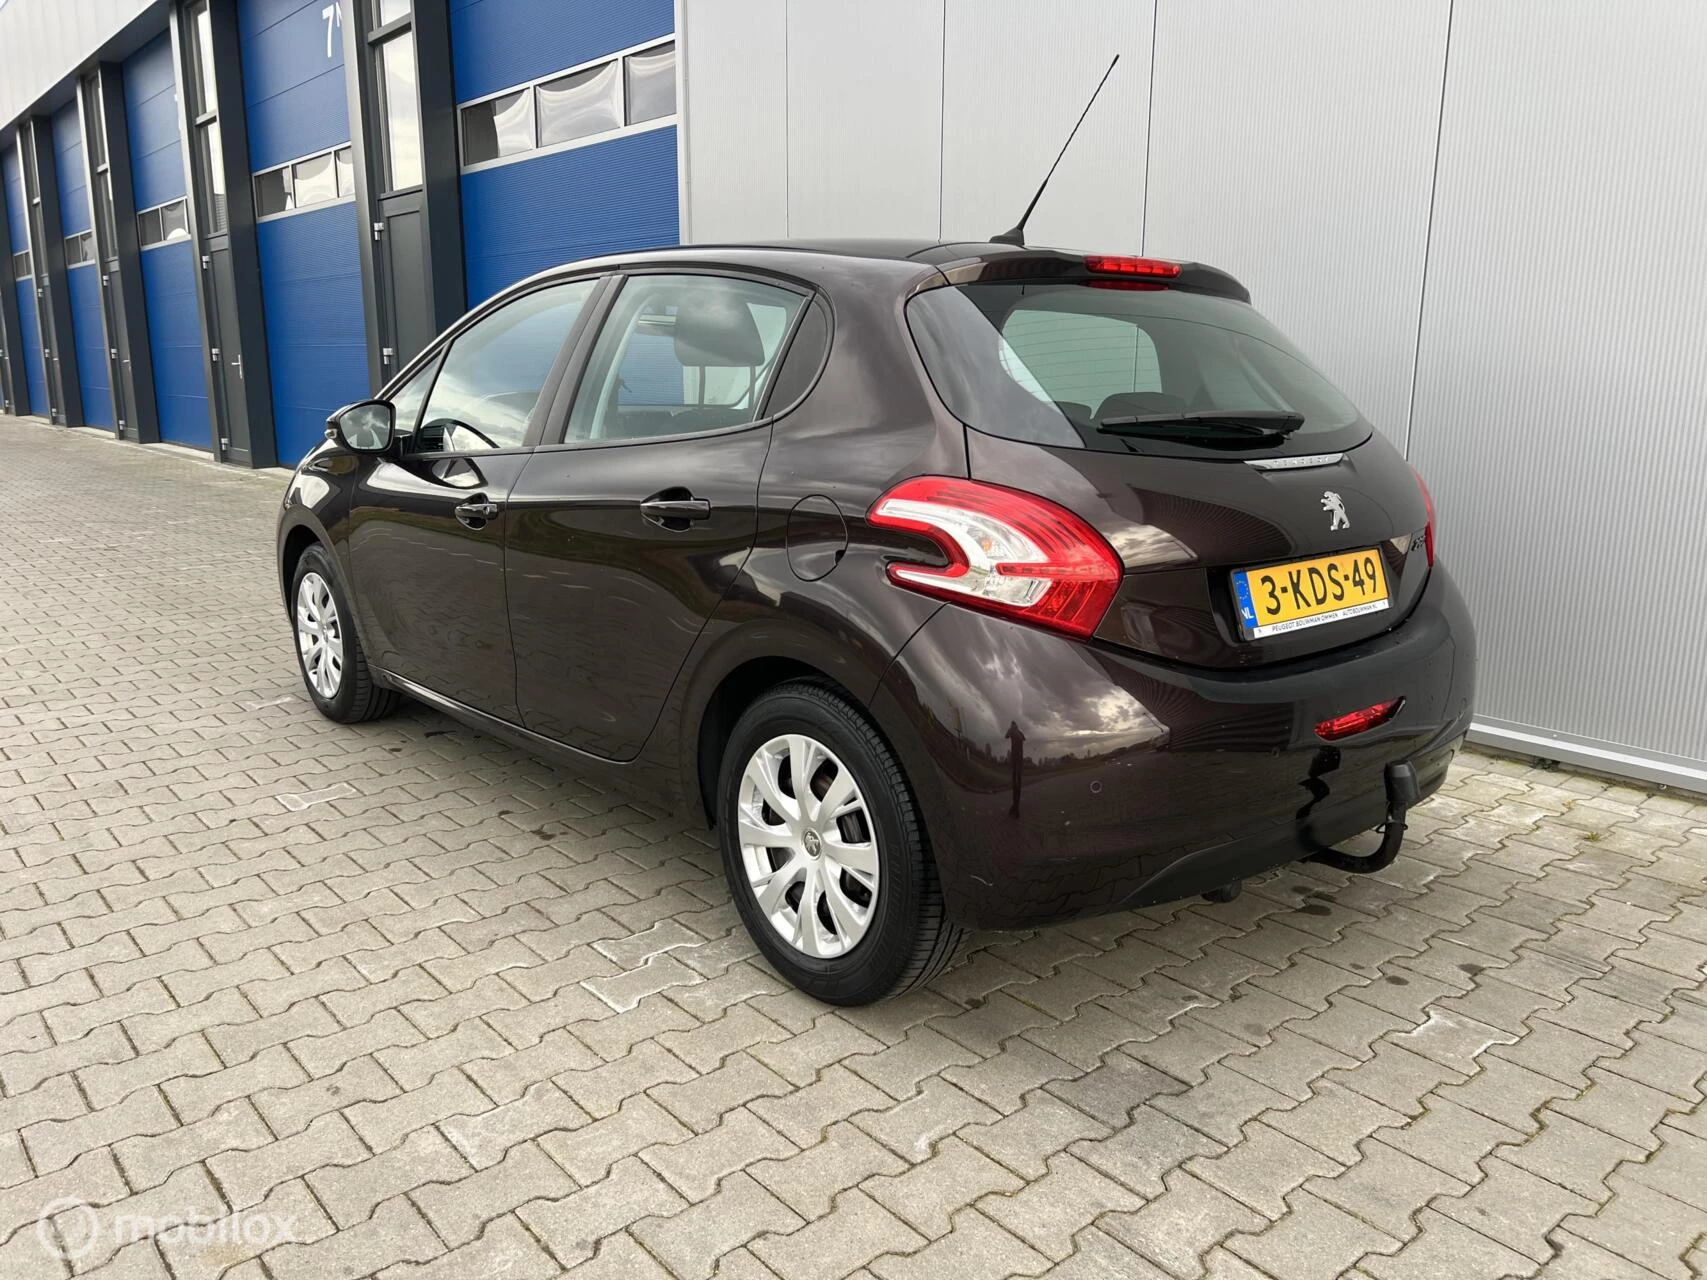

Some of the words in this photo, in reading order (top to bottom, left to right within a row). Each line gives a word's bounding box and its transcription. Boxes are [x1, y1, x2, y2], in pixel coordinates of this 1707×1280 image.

[1260, 557, 1377, 616] 3-KDS-49
[1241, 607, 1255, 620] NL
[1272, 621, 1296, 633] PEUGEOT
[1296, 617, 1321, 629] BOUWMAN
